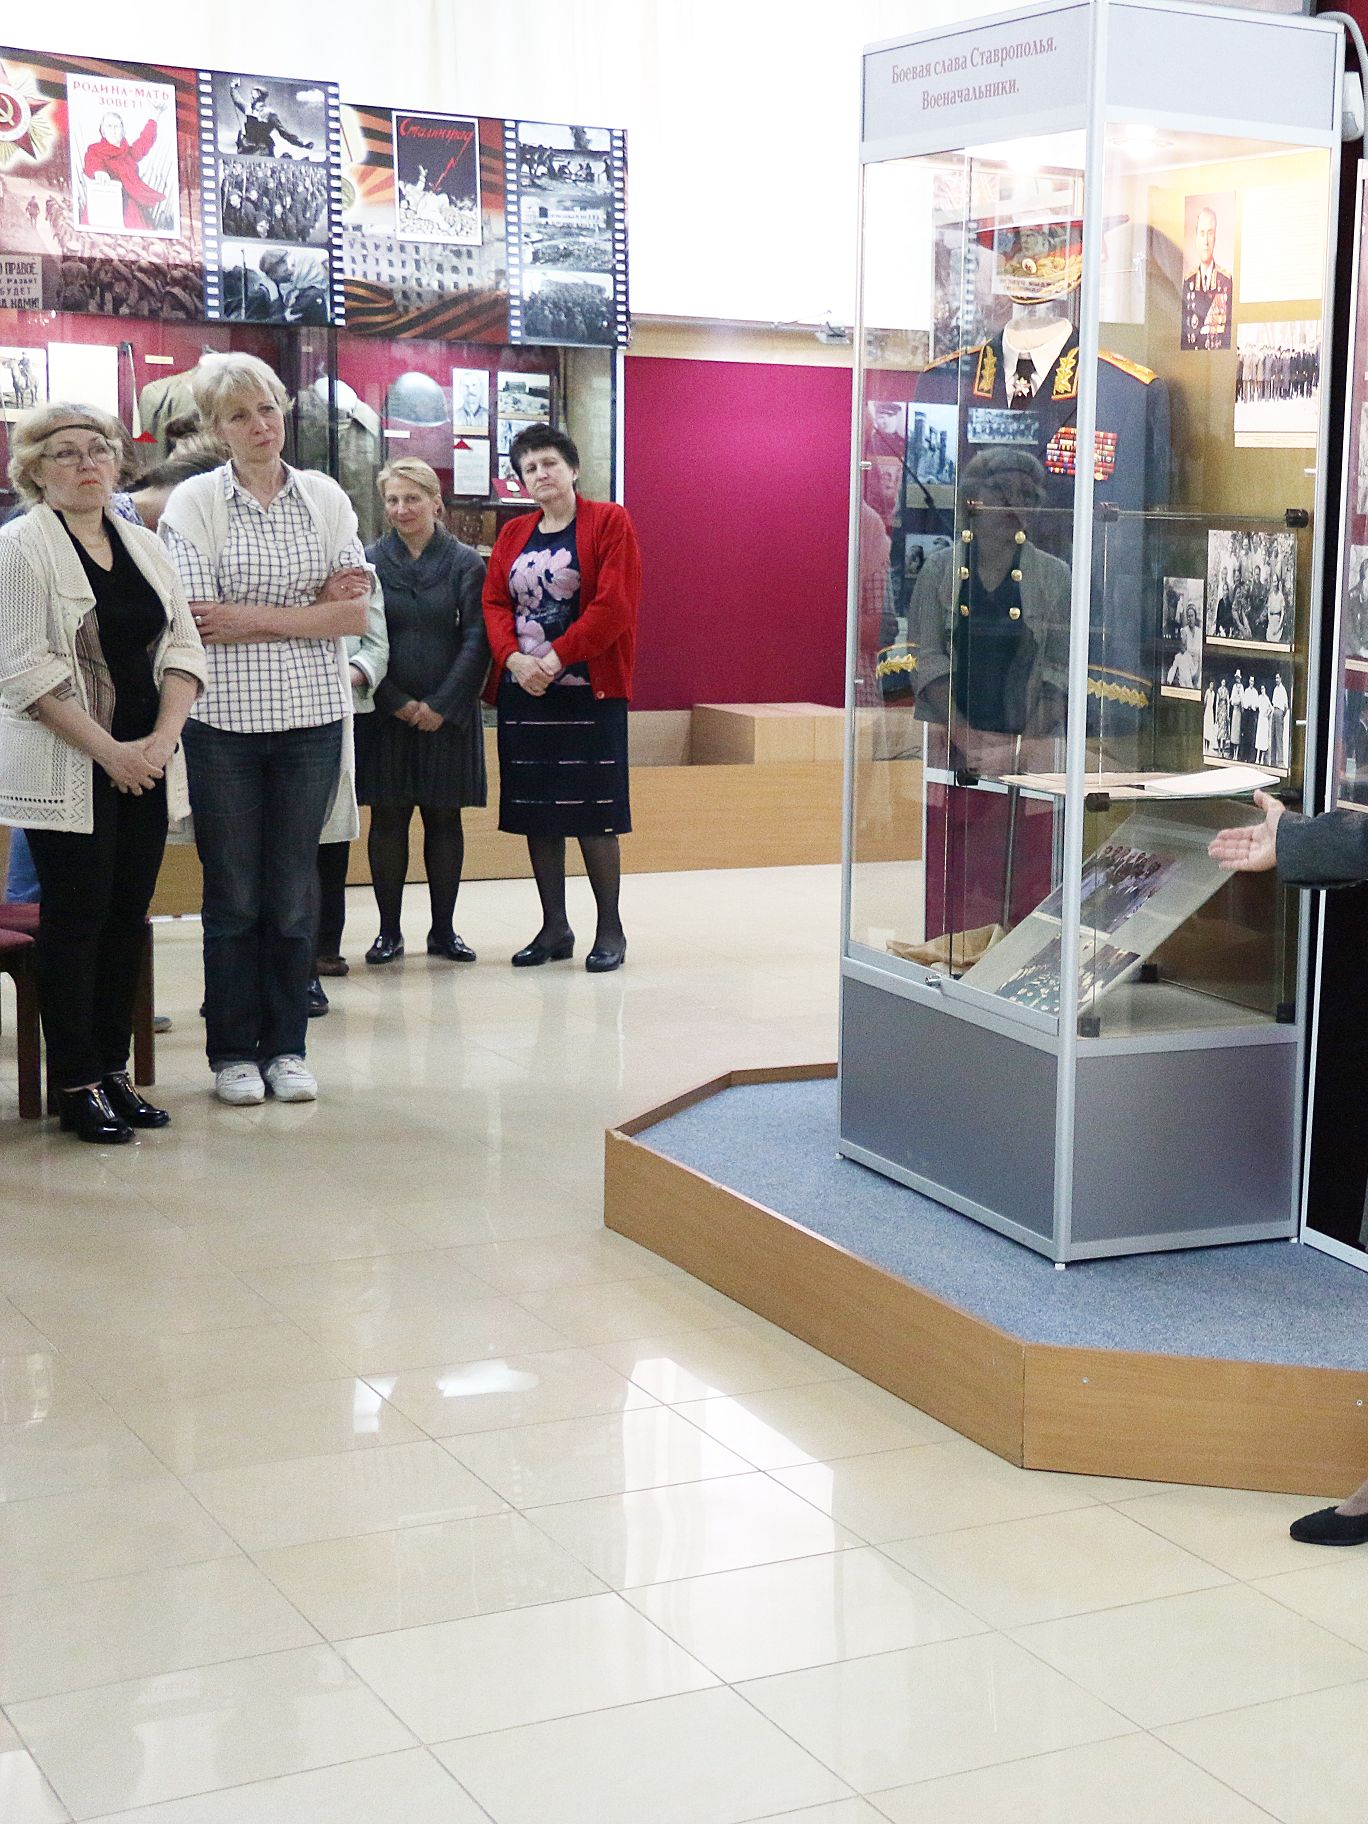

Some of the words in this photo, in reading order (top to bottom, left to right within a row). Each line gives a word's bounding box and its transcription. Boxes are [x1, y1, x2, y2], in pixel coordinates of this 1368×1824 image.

[891, 62, 932, 84] Боевая
[933, 53, 967, 76] слава
[970, 36, 1057, 68] Ставрополья.
[73, 80, 170, 101] РОДИНА-МАТЬ
[922, 78, 1020, 111] Военачальники.
